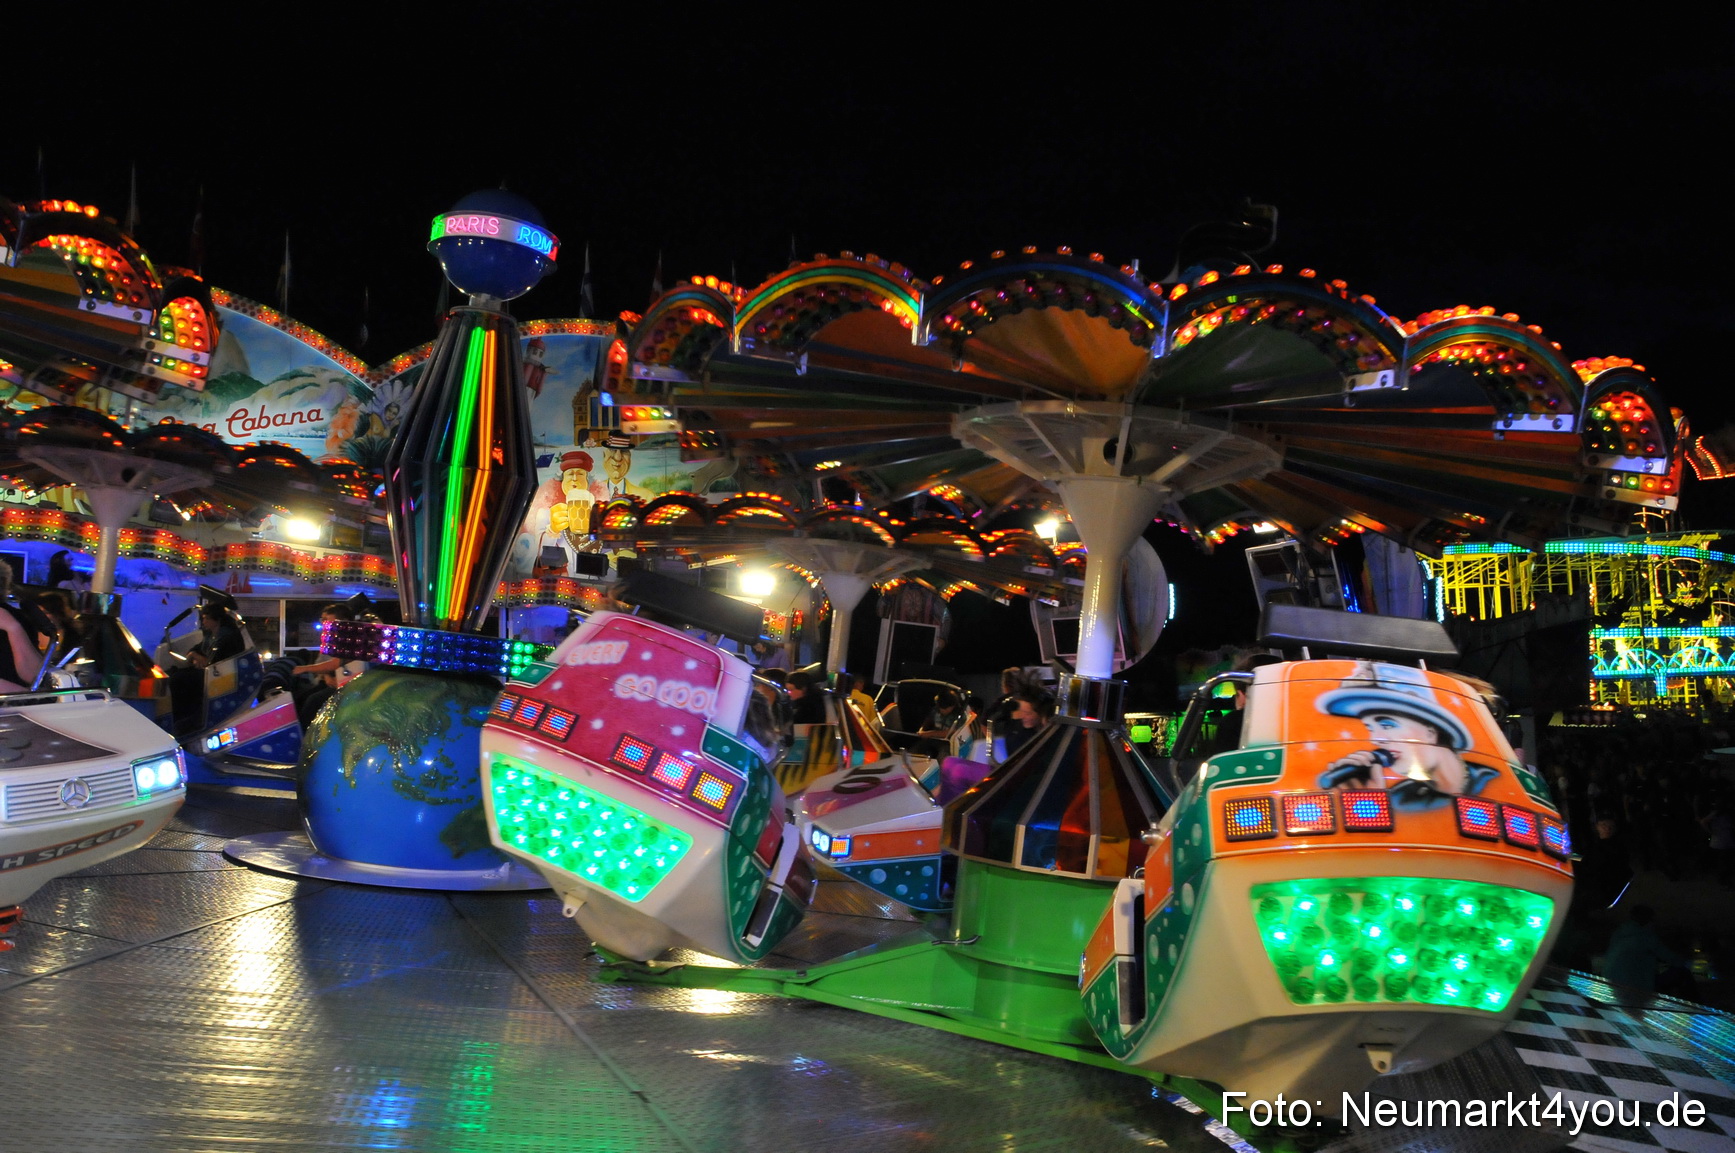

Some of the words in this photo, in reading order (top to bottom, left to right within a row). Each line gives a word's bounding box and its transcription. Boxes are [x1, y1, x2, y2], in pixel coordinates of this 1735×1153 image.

[445, 216, 500, 235] PARIS
[517, 226, 553, 255] ROM
[225, 395, 324, 438] Cabana
[616, 675, 657, 701] GO
[37, 823, 136, 862] SPEED
